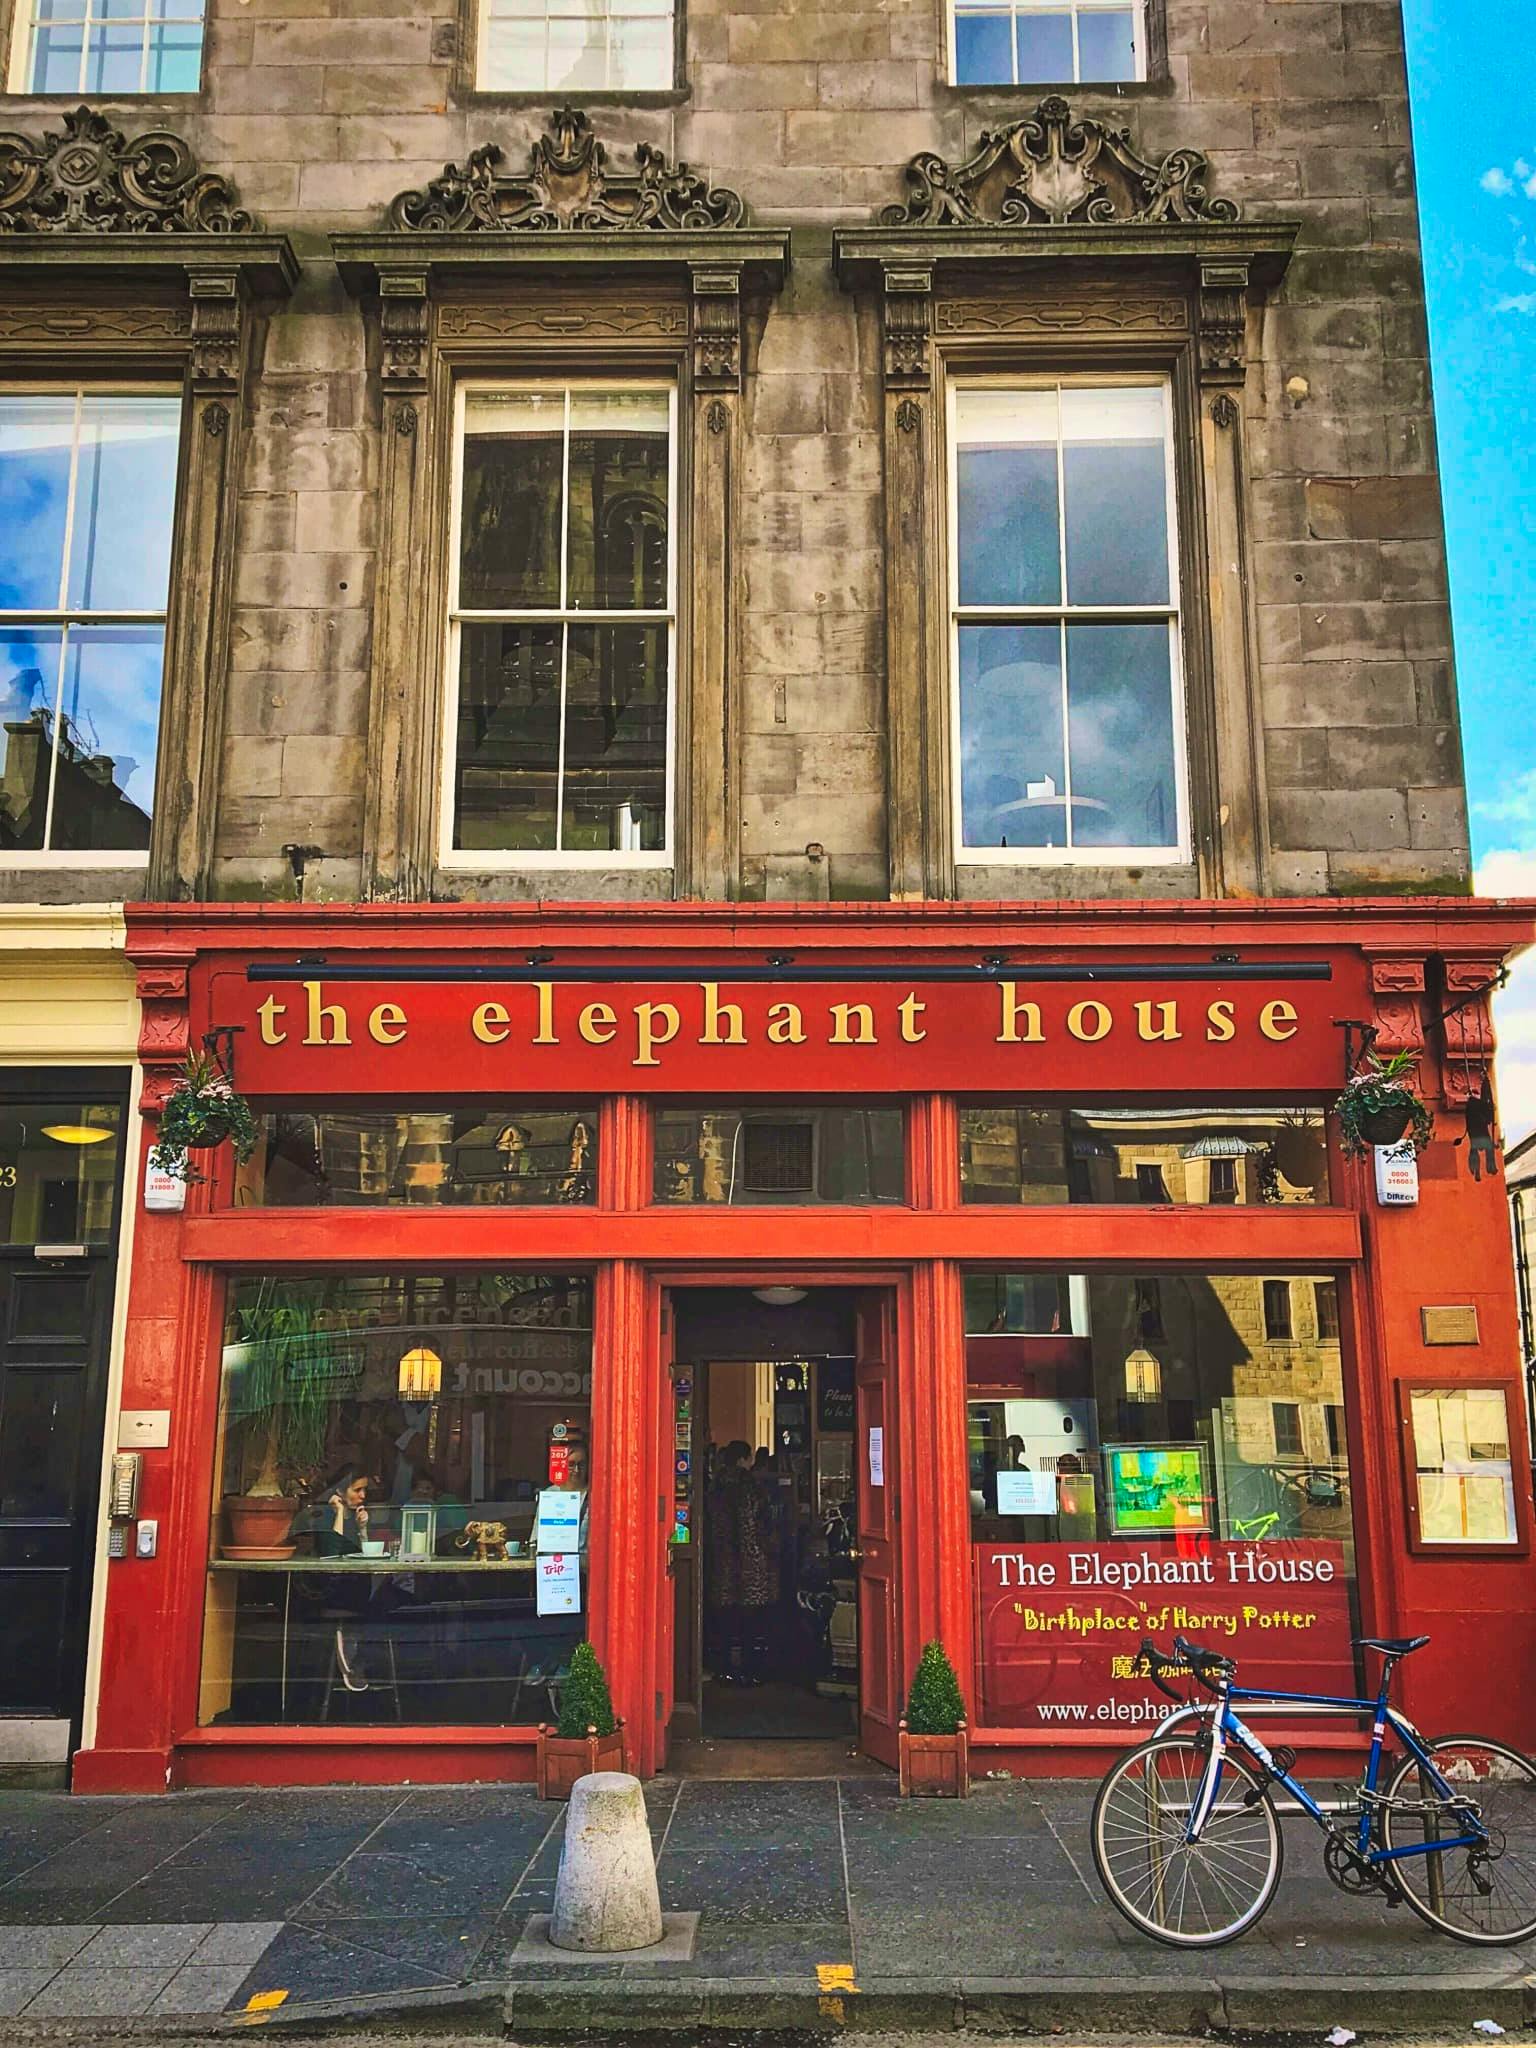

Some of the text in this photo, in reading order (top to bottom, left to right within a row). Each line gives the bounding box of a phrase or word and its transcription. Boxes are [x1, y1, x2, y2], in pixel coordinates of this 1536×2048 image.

[257, 980, 1298, 1065] the elephant house
[992, 1551, 1334, 1590] The Elephant House
[1148, 1610, 1169, 1632] of
[1173, 1606, 1237, 1635] Harry
[1242, 1606, 1316, 1629] Potter
